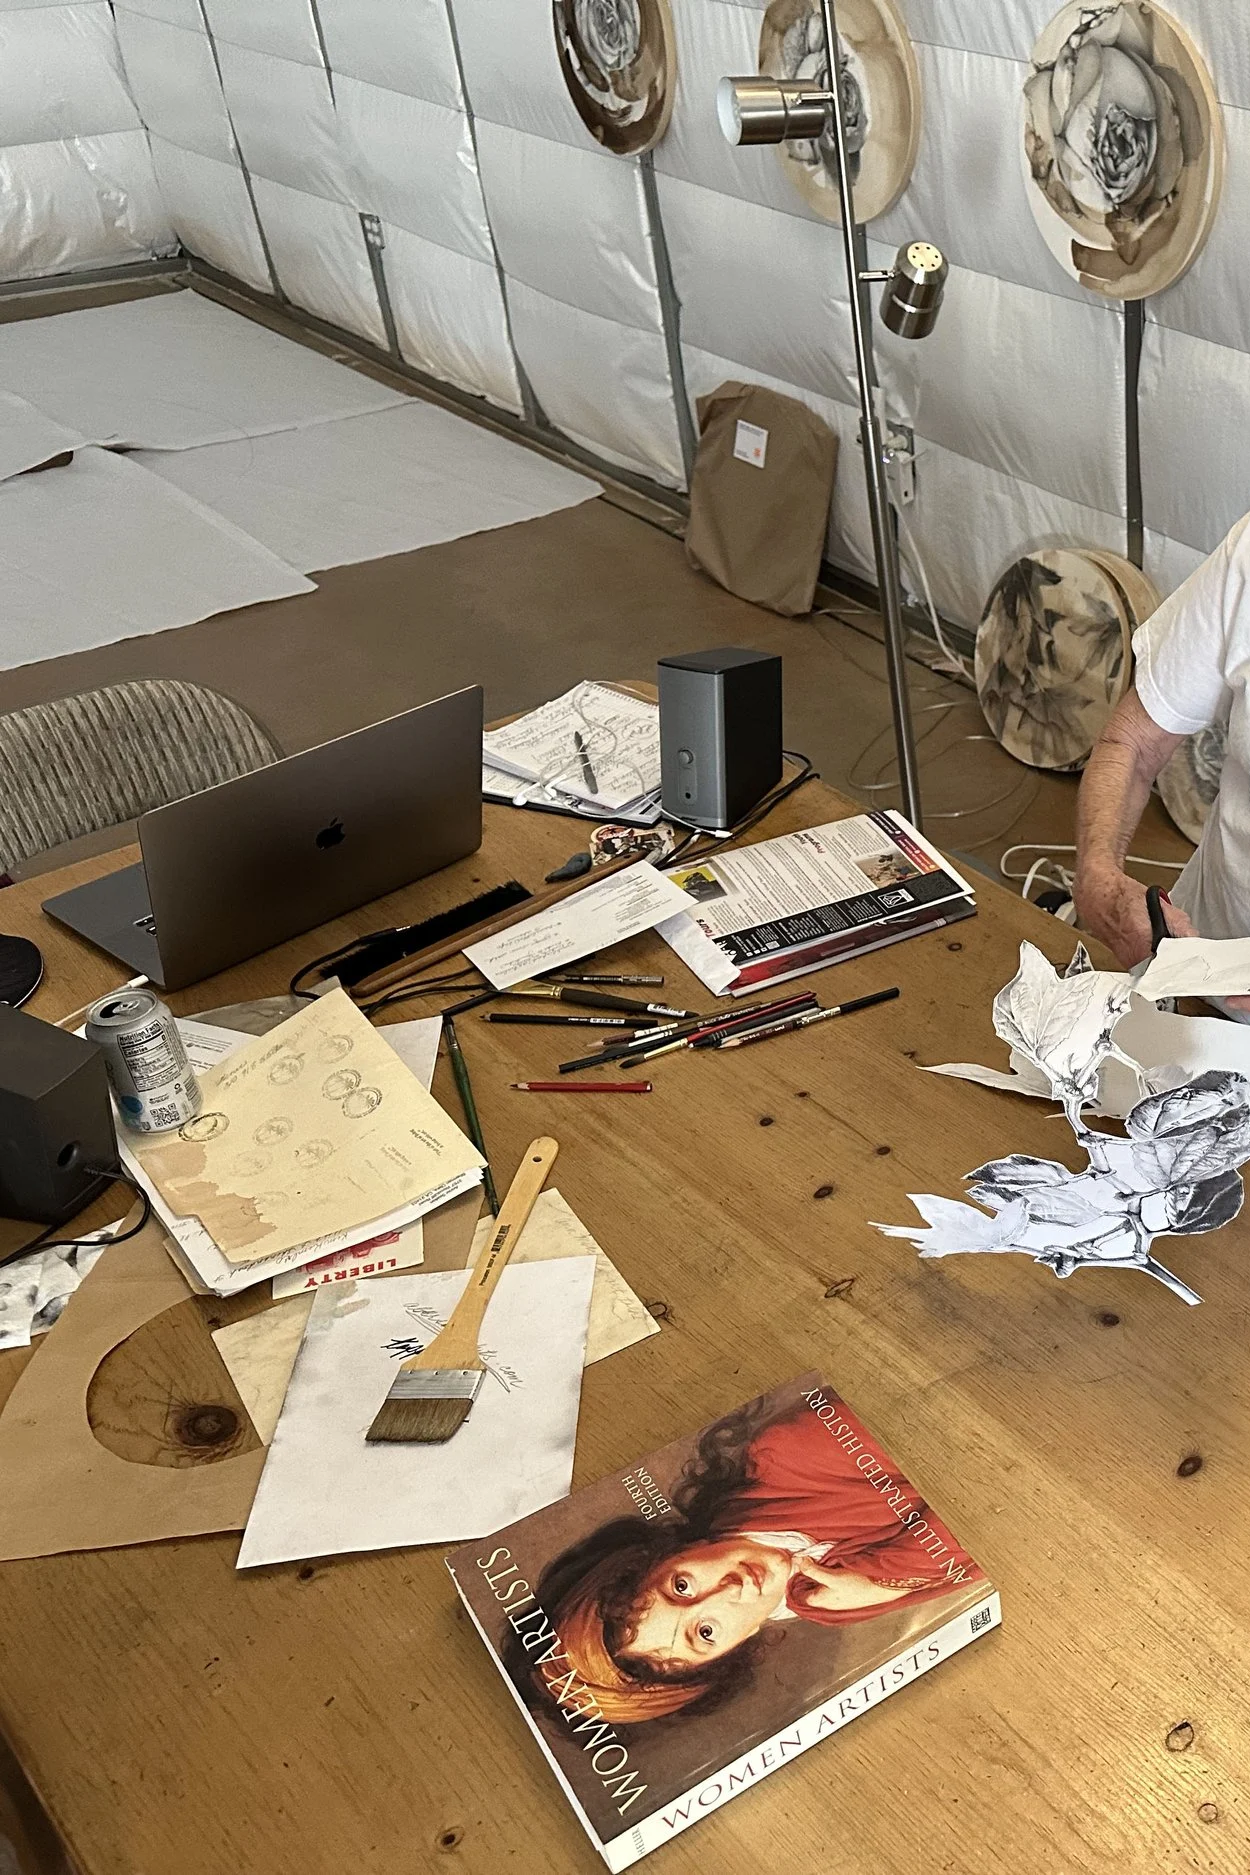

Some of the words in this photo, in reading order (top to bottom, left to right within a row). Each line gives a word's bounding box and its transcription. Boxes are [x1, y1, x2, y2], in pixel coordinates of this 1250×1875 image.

[302, 1257, 397, 1288] LIBERTY
[800, 1386, 864, 1458] HISTORY
[621, 1475, 655, 1521] FOURTH
[634, 1466, 671, 1515] EDITION
[855, 1451, 949, 1568] ILLUSTRATED
[938, 1556, 971, 1585] AN
[476, 1546, 569, 1674] ARTISTS
[545, 1677, 648, 1816] WOMEN
[662, 1728, 803, 1829] WOMEN
[816, 1639, 941, 1735] ARTISTS
